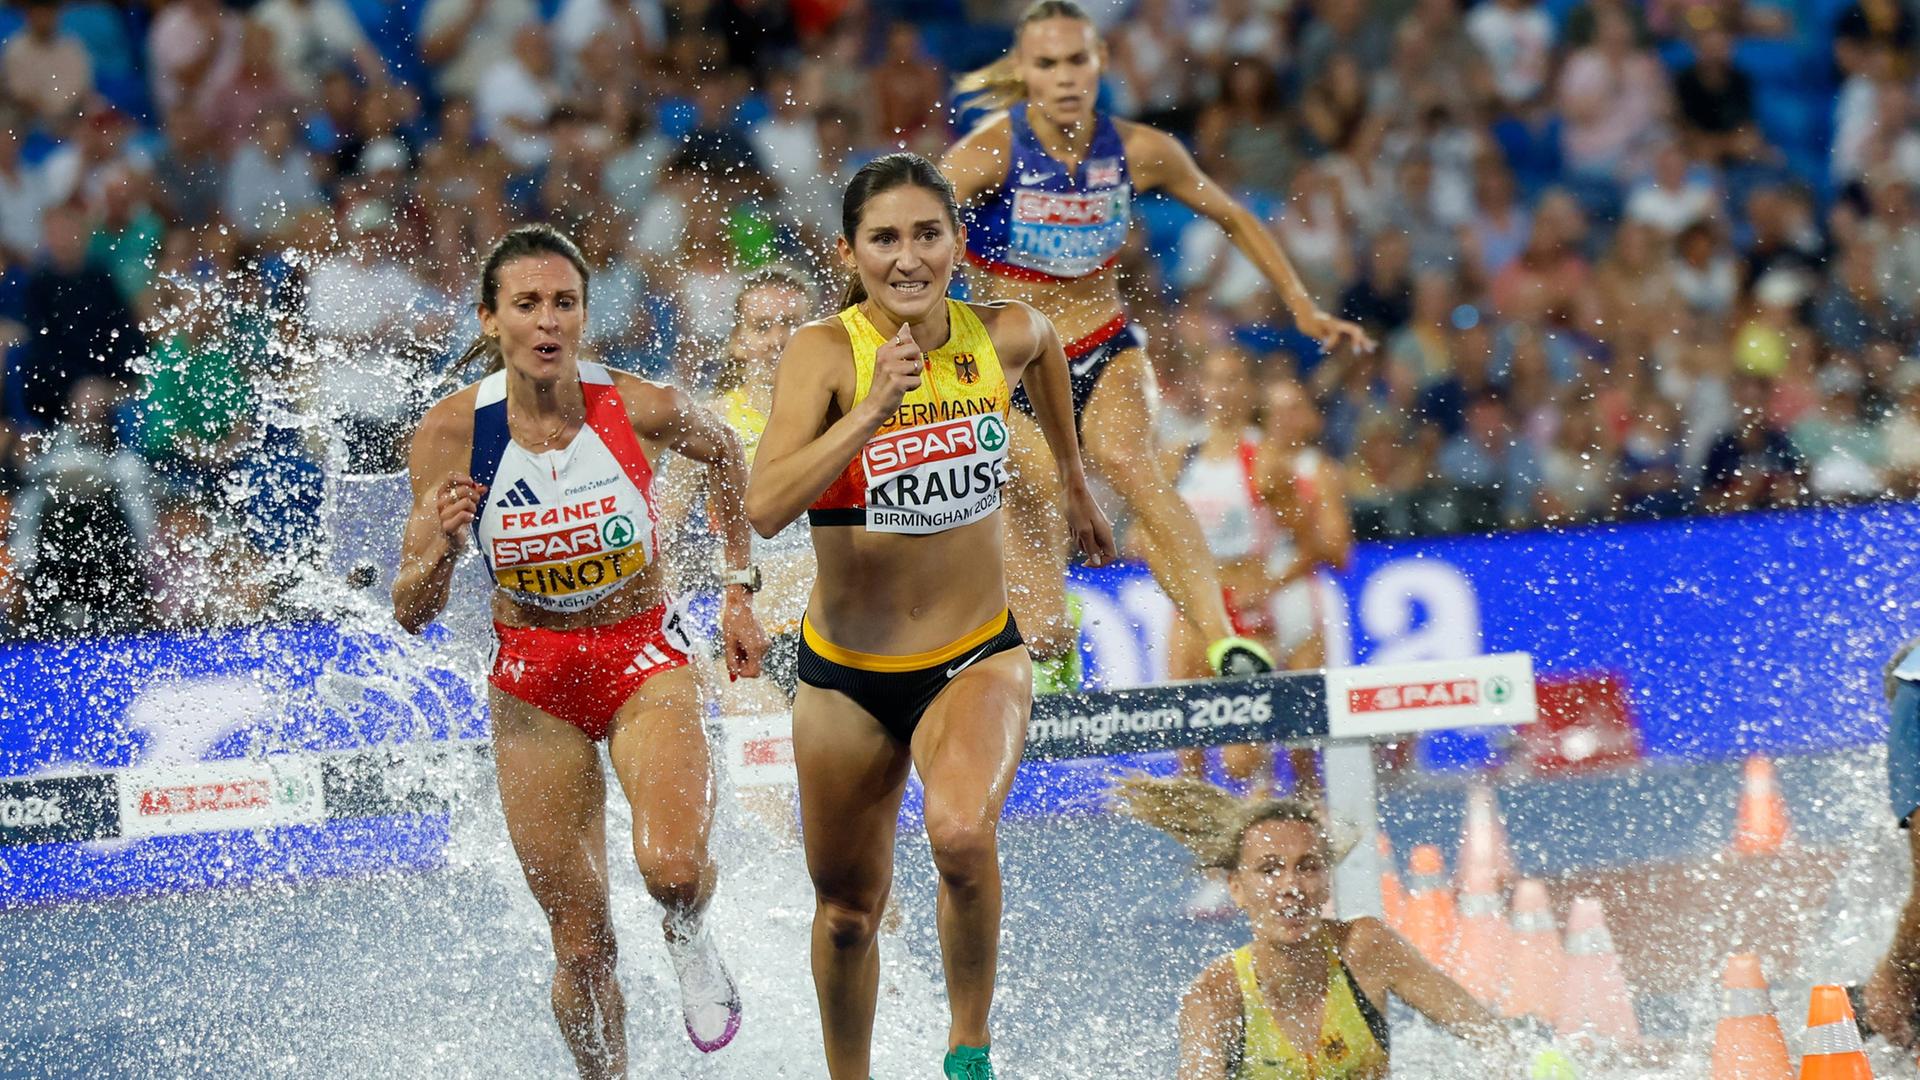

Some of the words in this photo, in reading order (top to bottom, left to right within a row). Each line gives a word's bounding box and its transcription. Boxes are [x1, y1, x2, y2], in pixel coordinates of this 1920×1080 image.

[1021, 194, 1106, 224] SPAR
[869, 426, 974, 471] SPAR
[871, 457, 1006, 507] KRAUSE
[502, 496, 617, 531] FRANCE
[873, 507, 973, 527] BIRMINGHAM
[974, 491, 997, 515] 2026
[496, 531, 599, 565] SPAR
[516, 553, 626, 594] FINOT
[1372, 682, 1477, 709] SPAR
[1028, 705, 1184, 744] mingham
[1188, 692, 1272, 729] 2026
[0, 795, 61, 828] 026
